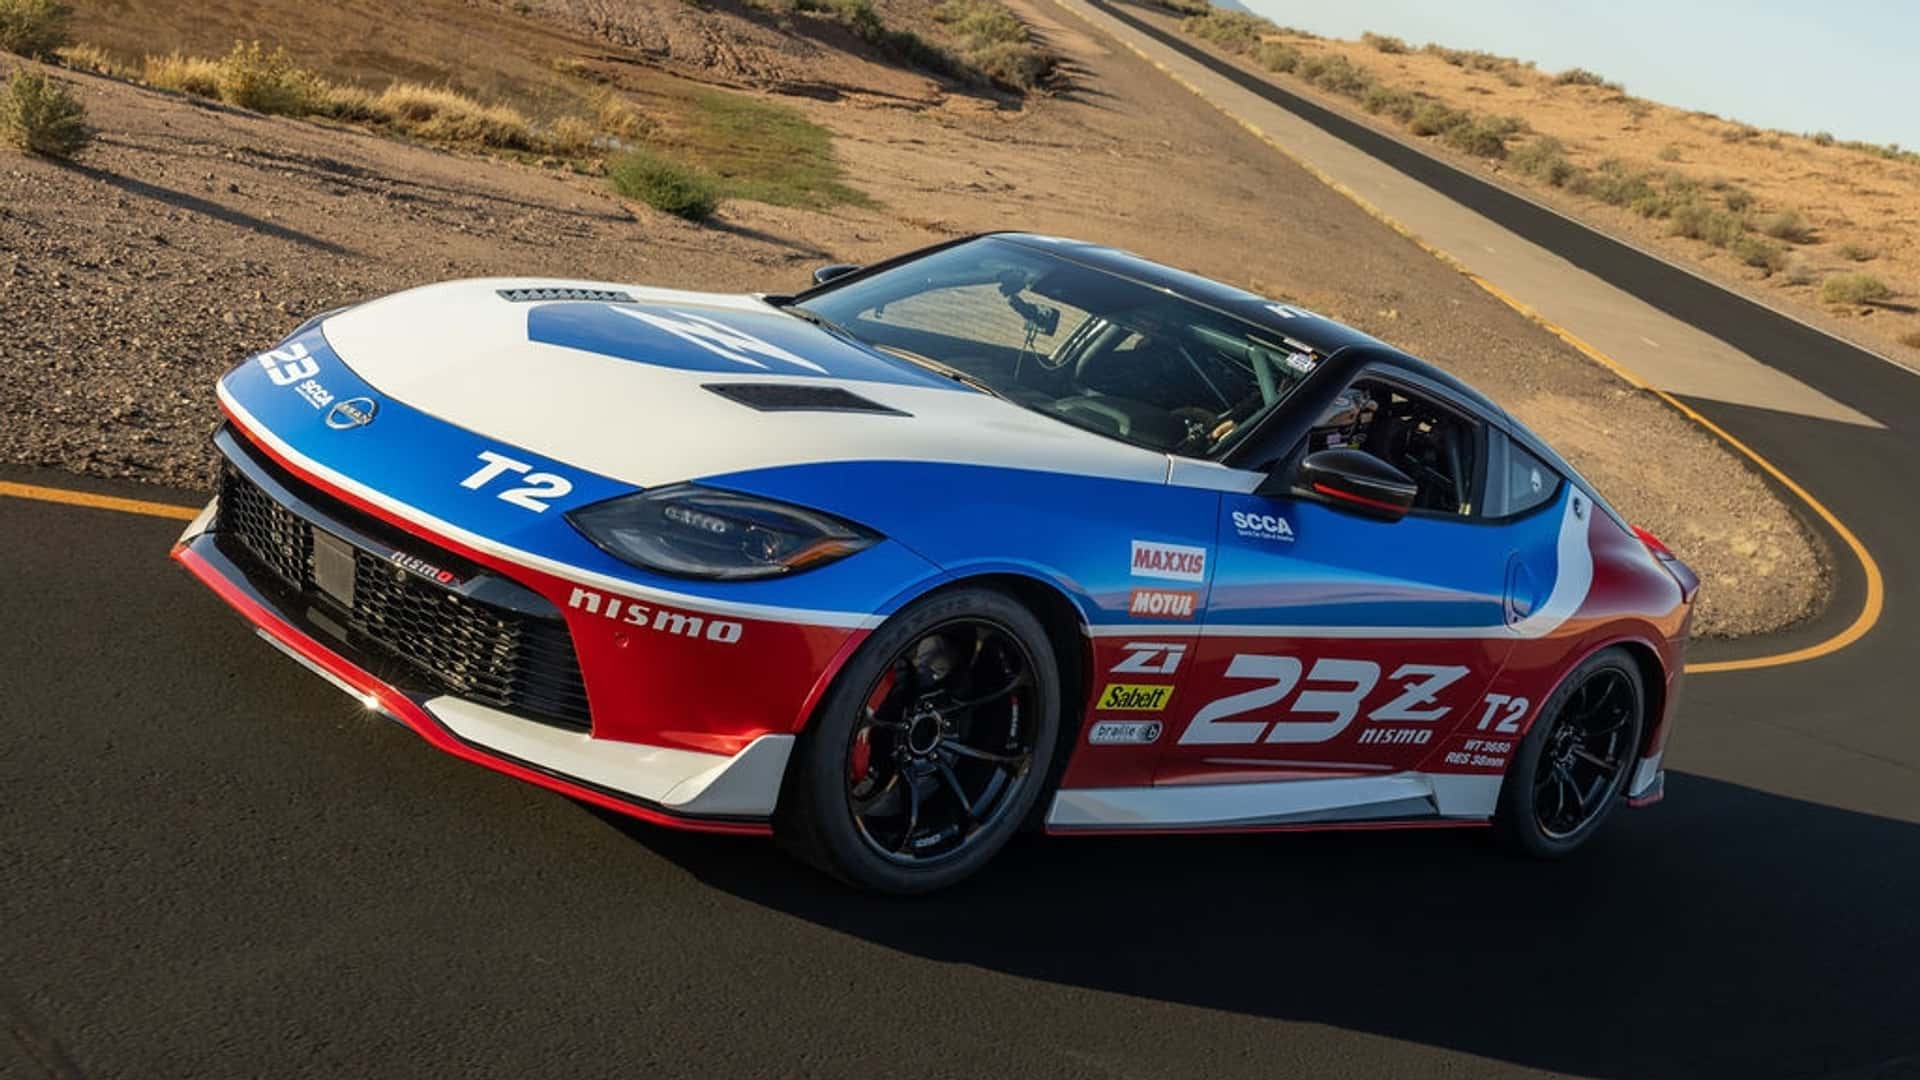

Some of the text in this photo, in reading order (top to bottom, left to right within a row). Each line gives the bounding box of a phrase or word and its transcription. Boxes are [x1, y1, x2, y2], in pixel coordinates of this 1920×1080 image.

[258, 342, 320, 386] 23
[299, 379, 335, 408] SCCA
[459, 450, 573, 513] T2
[1232, 511, 1294, 536] SCCA
[1133, 548, 1203, 573] MAXXIS
[1132, 591, 1193, 616] MOTUL
[1105, 686, 1165, 708] Sabelt
[1476, 693, 1529, 733] T2
[1445, 751, 1471, 765] RES
[1464, 739, 1484, 752] WT
